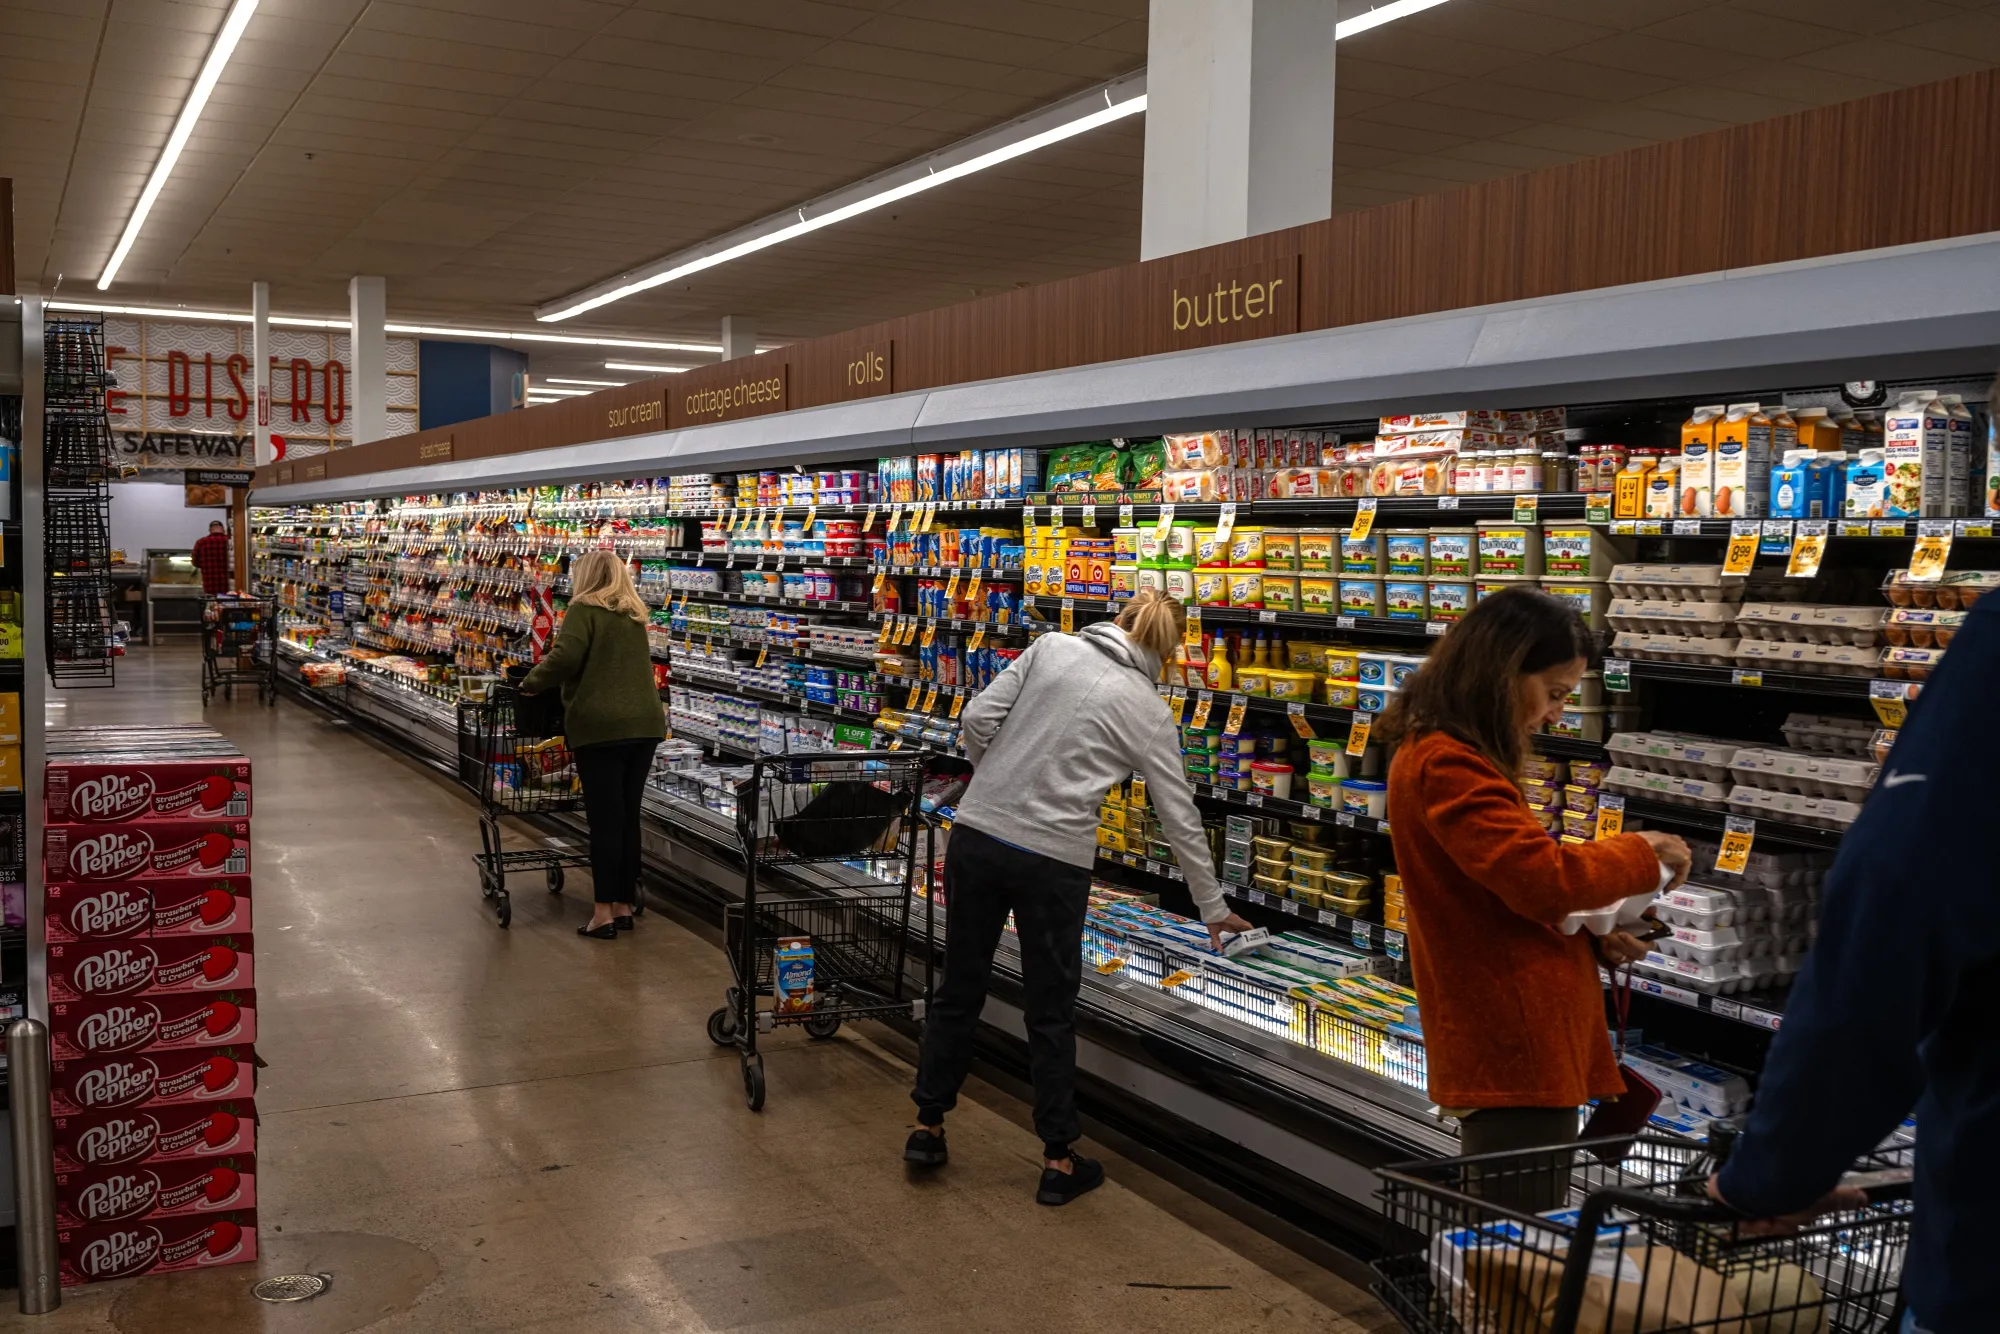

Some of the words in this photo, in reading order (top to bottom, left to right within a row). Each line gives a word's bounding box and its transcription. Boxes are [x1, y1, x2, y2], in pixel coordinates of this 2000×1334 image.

[1172, 278, 1283, 331] butter
[848, 352, 885, 386] rolls
[168, 351, 344, 425] BISRO
[686, 385, 731, 420] cottage
[733, 376, 781, 406] cheese
[608, 408, 628, 428] sour
[630, 400, 662, 424] cream
[124, 432, 247, 457] SAFEWAY
[1731, 545, 1751, 562] 899
[1796, 546, 1818, 561] 499
[1919, 548, 1942, 563] 749
[1066, 583, 1084, 592] IMPERIAL
[1088, 585, 1107, 593] IMPERIAL
[851, 730, 866, 738] OFF
[237, 766, 248, 774] 12
[102, 775, 131, 795] Dr
[155, 783, 208, 803] Strawberries
[77, 780, 149, 816] Pepper
[166, 797, 192, 809] Cream
[1601, 818, 1618, 835] 449
[100, 833, 130, 854] Dr
[154, 840, 207, 862] Strawberries
[1725, 841, 1745, 859] 649
[75, 839, 148, 875] Pepper
[156, 860, 163, 869] &
[164, 854, 191, 867] Cream
[48, 887, 60, 895] 12
[101, 891, 130, 912] Dr
[155, 897, 208, 919] Strawberries
[76, 898, 149, 933] Pepper
[157, 917, 164, 926] &
[166, 910, 192, 924] Cream
[1243, 934, 1249, 942] 1
[1264, 930, 1269, 939] 1
[104, 950, 133, 970] Dr
[158, 953, 211, 976] Strawberries
[80, 956, 152, 992] Pepper
[160, 975, 167, 983] &
[168, 967, 195, 981] Cream
[783, 968, 813, 980] Almond
[108, 1007, 136, 1026] Dr
[161, 1009, 213, 1032] Strawberries
[85, 1012, 155, 1050] Pepper
[163, 1031, 170, 1039] &
[172, 1023, 198, 1036] Cream
[53, 1061, 65, 1069] 12
[106, 1063, 134, 1082] Dr
[83, 1067, 152, 1105] Pepper
[159, 1064, 211, 1089] Strawberries
[162, 1086, 168, 1094] &
[170, 1078, 196, 1092] Cream
[55, 1119, 67, 1127] 12
[107, 1119, 135, 1140] Dr
[160, 1120, 212, 1144] Strawberries
[84, 1124, 154, 1162] Pepper
[163, 1142, 169, 1150] &
[171, 1134, 196, 1148] Cream
[56, 1174, 68, 1183] 12
[108, 1176, 136, 1196] Dr
[161, 1176, 213, 1200] Strawberries
[85, 1180, 154, 1218] Pepper
[164, 1198, 170, 1206] &
[172, 1190, 198, 1204] Cream
[58, 1232, 70, 1240] 12
[110, 1232, 138, 1251] Dr
[163, 1230, 215, 1254] Strawberries
[87, 1236, 157, 1274] Pepper
[166, 1252, 172, 1261] &
[174, 1245, 199, 1259] Cream
